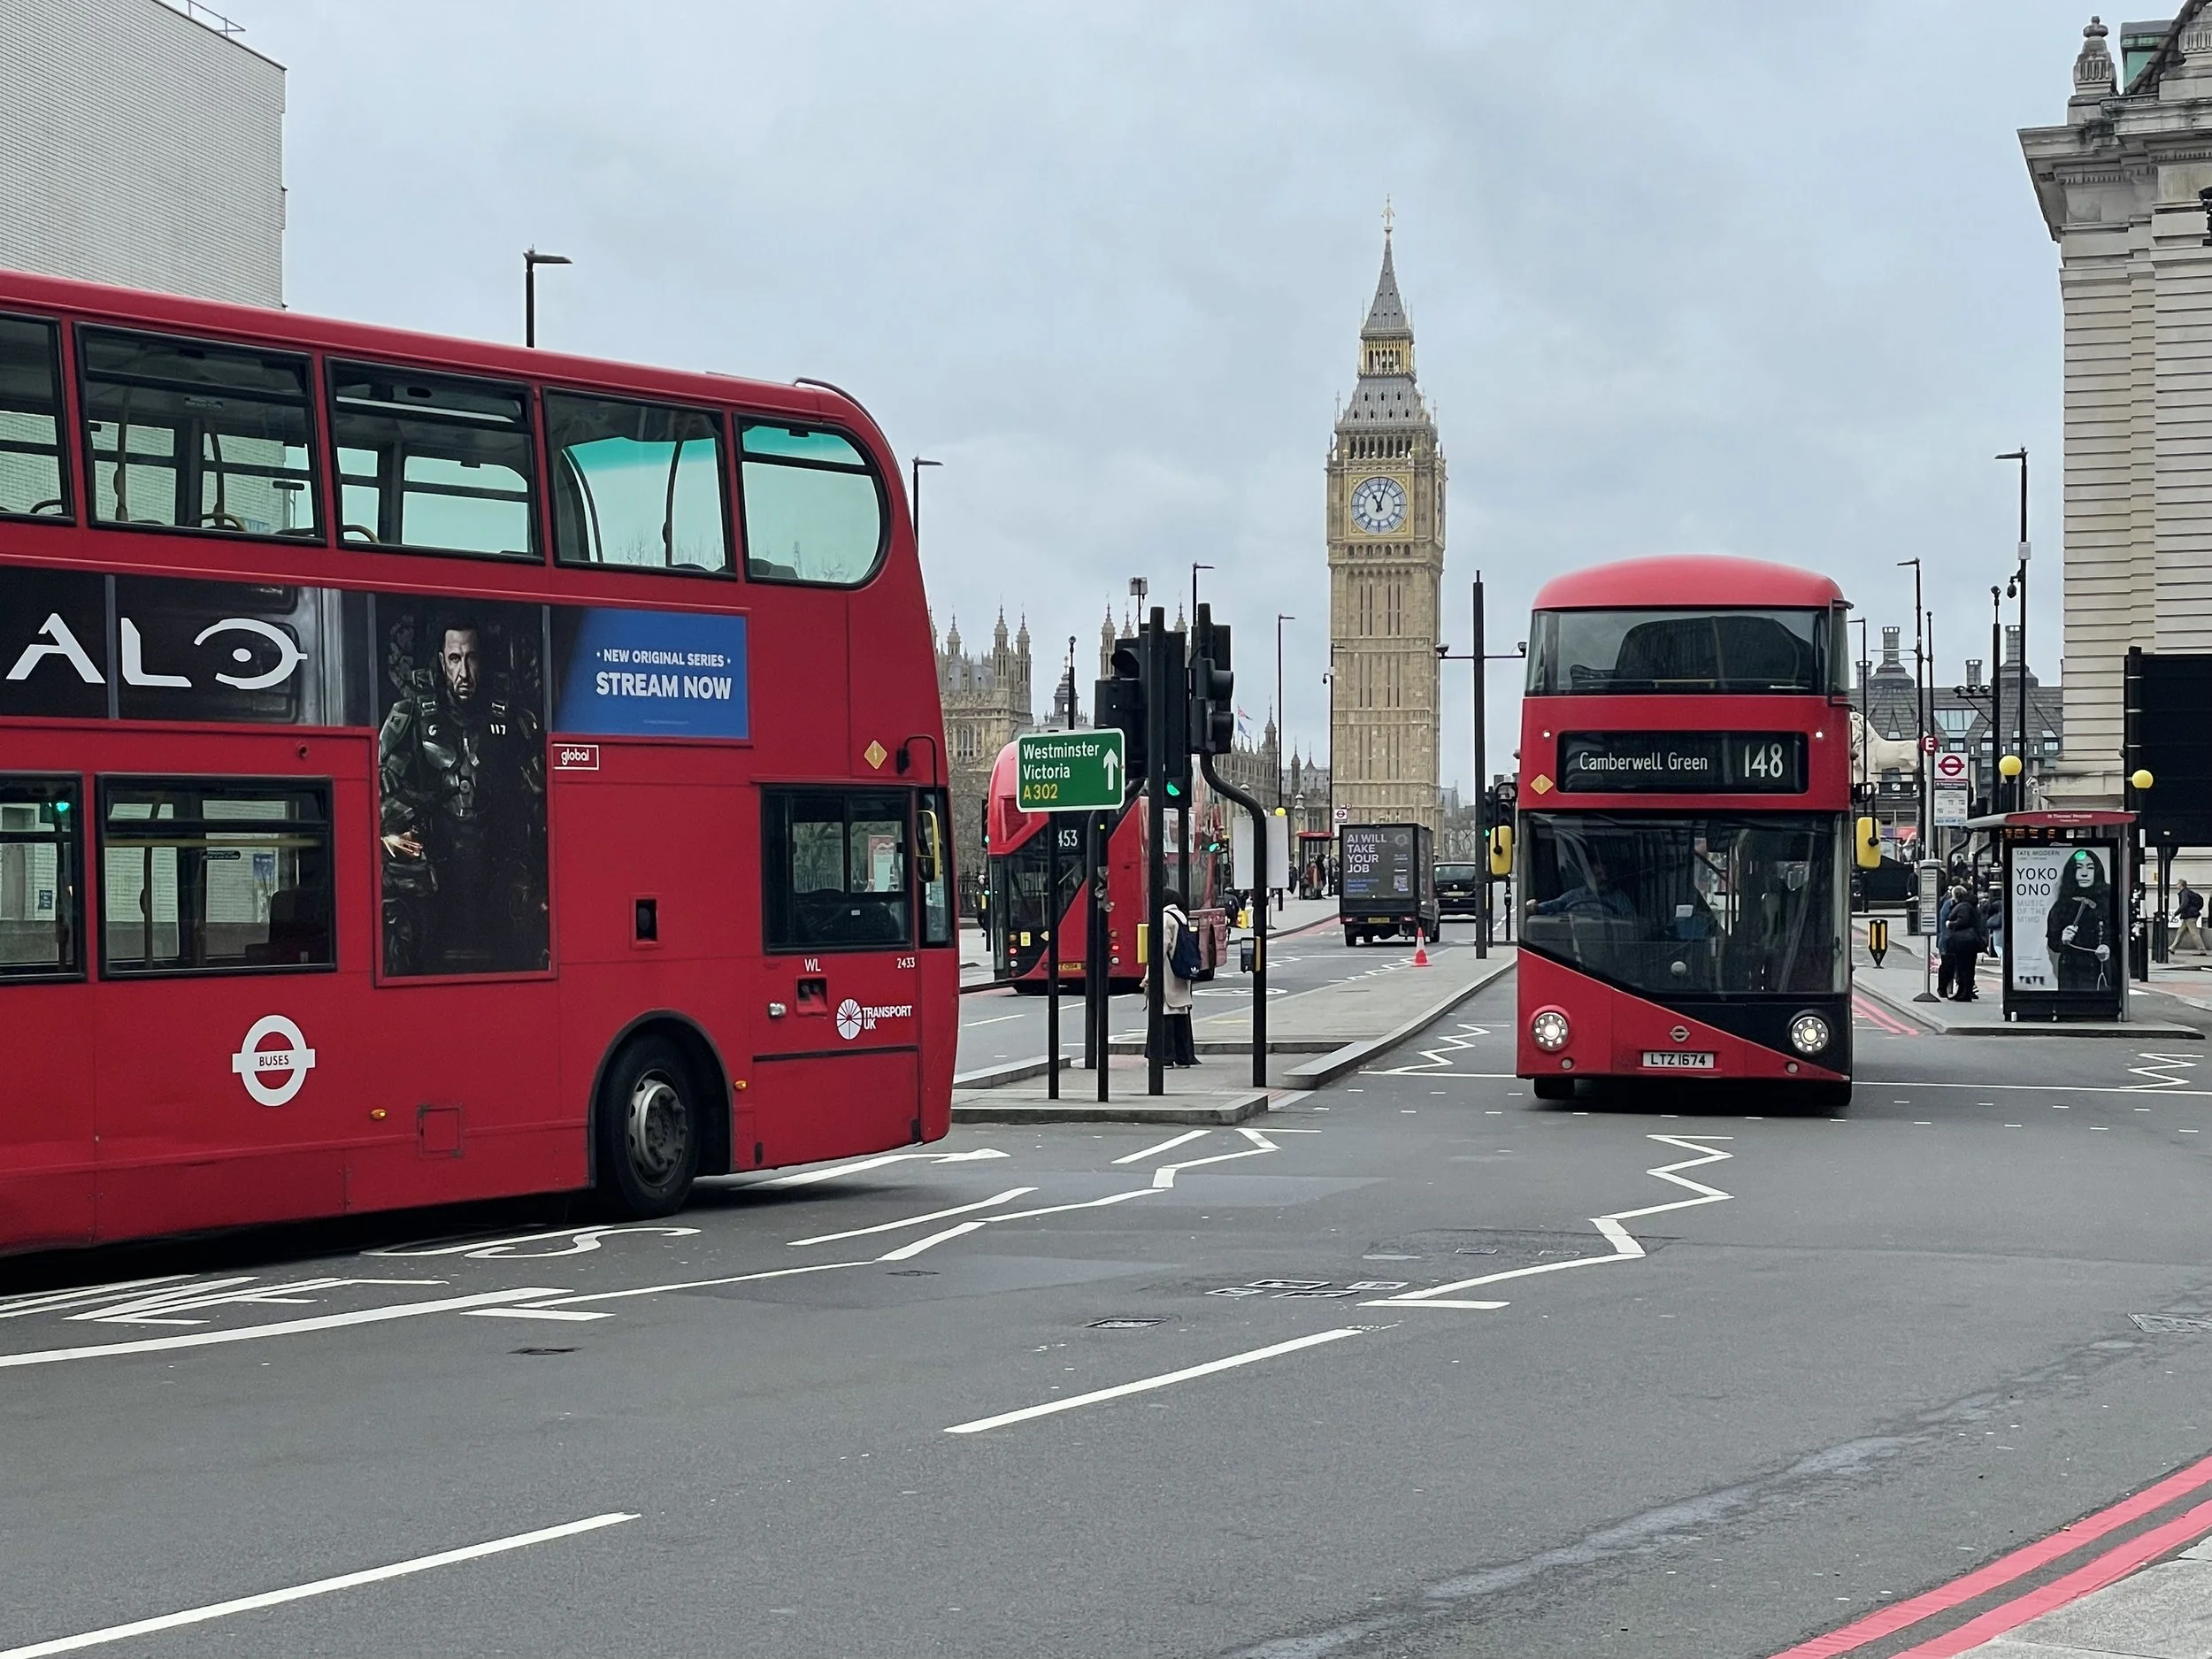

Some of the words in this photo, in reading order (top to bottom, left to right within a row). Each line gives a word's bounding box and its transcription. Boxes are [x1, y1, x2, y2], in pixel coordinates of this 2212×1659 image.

[603, 649, 629, 663] NEW
[632, 650, 685, 665] ORIGINAL
[687, 654, 724, 667] SERIES
[596, 672, 679, 697] STREAM
[684, 676, 732, 699] NOW
[490, 724, 506, 735] 117
[1925, 737, 1934, 750] E
[1023, 741, 1100, 759] Westminster
[561, 748, 589, 765] global
[1579, 752, 1663, 771] Camberwell
[1668, 752, 1708, 771] Green
[1744, 743, 1784, 778] 148
[1023, 763, 1071, 780] Victoria
[1023, 784, 1058, 800] A302
[1348, 834, 1358, 843] AI
[1361, 833, 1386, 843] WILL
[1348, 844, 1375, 853] TAKE
[1348, 854, 1379, 863] YOUR
[1348, 864, 1370, 873] JOB
[2016, 868, 2057, 879] YOKO
[2016, 884, 2050, 895] ONO
[805, 958, 821, 972] WL
[897, 957, 916, 969] 2433
[862, 1005, 912, 1018] TRANSPORT
[864, 1018, 877, 1030] UK
[259, 1055, 289, 1066] BUSES
[1651, 1054, 1675, 1064] LTZ
[1678, 1054, 1706, 1066] 1674
